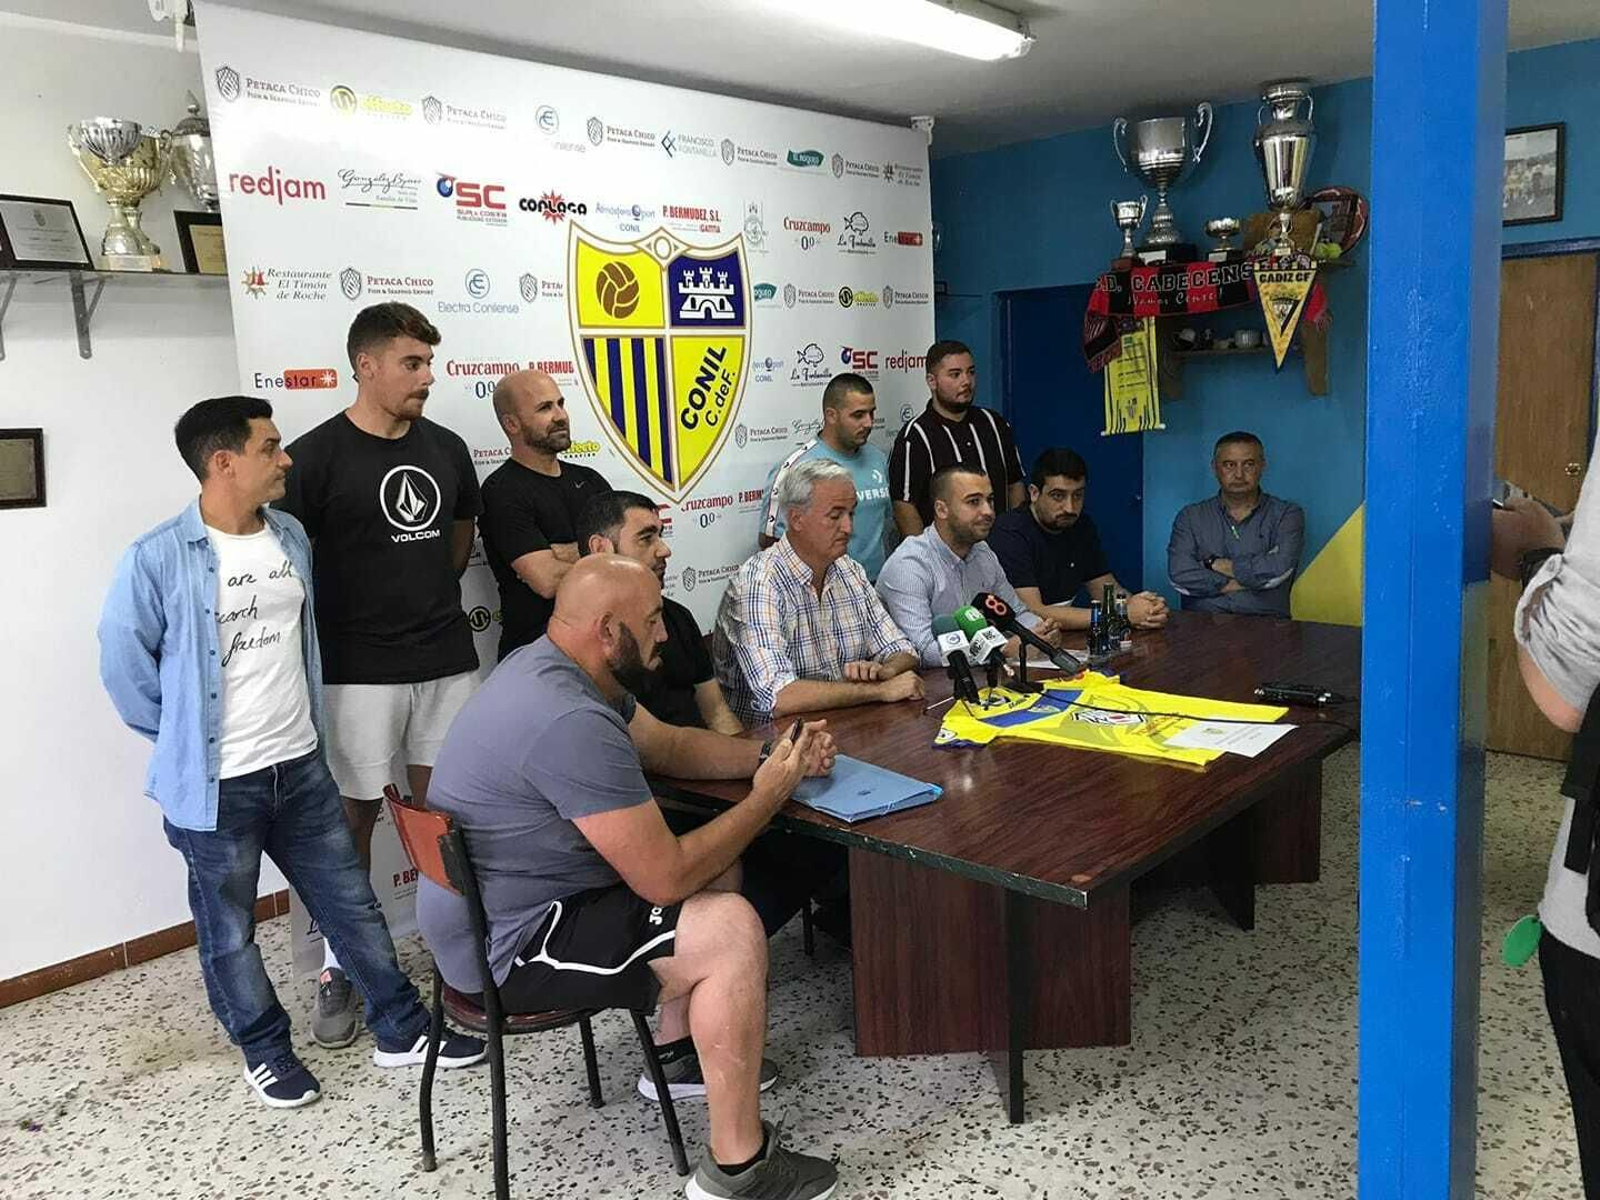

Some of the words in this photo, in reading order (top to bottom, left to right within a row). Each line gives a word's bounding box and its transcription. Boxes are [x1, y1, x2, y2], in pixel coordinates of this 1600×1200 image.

[229, 165, 326, 205] redjam
[783, 216, 831, 234] Cruzcampo
[267, 268, 333, 280] Restaurante
[367, 275, 403, 287] PETACA
[405, 276, 434, 288] CHICO
[1130, 261, 1254, 292] CABECENS
[1258, 270, 1293, 284] CADIZ
[1295, 270, 1312, 283] CF
[278, 281, 291, 291] El
[276, 291, 290, 301] de
[292, 292, 327, 302] Roche
[438, 302, 472, 314] Electra
[446, 359, 520, 376] Cruzcampo
[885, 350, 927, 374] redjam
[254, 372, 317, 389] Enestar
[680, 346, 727, 430] CONIL
[391, 529, 441, 543] VOLCOM
[227, 573, 257, 588] are
[269, 559, 293, 579] all
[221, 626, 281, 668] freedom
[648, 906, 663, 926] JO
